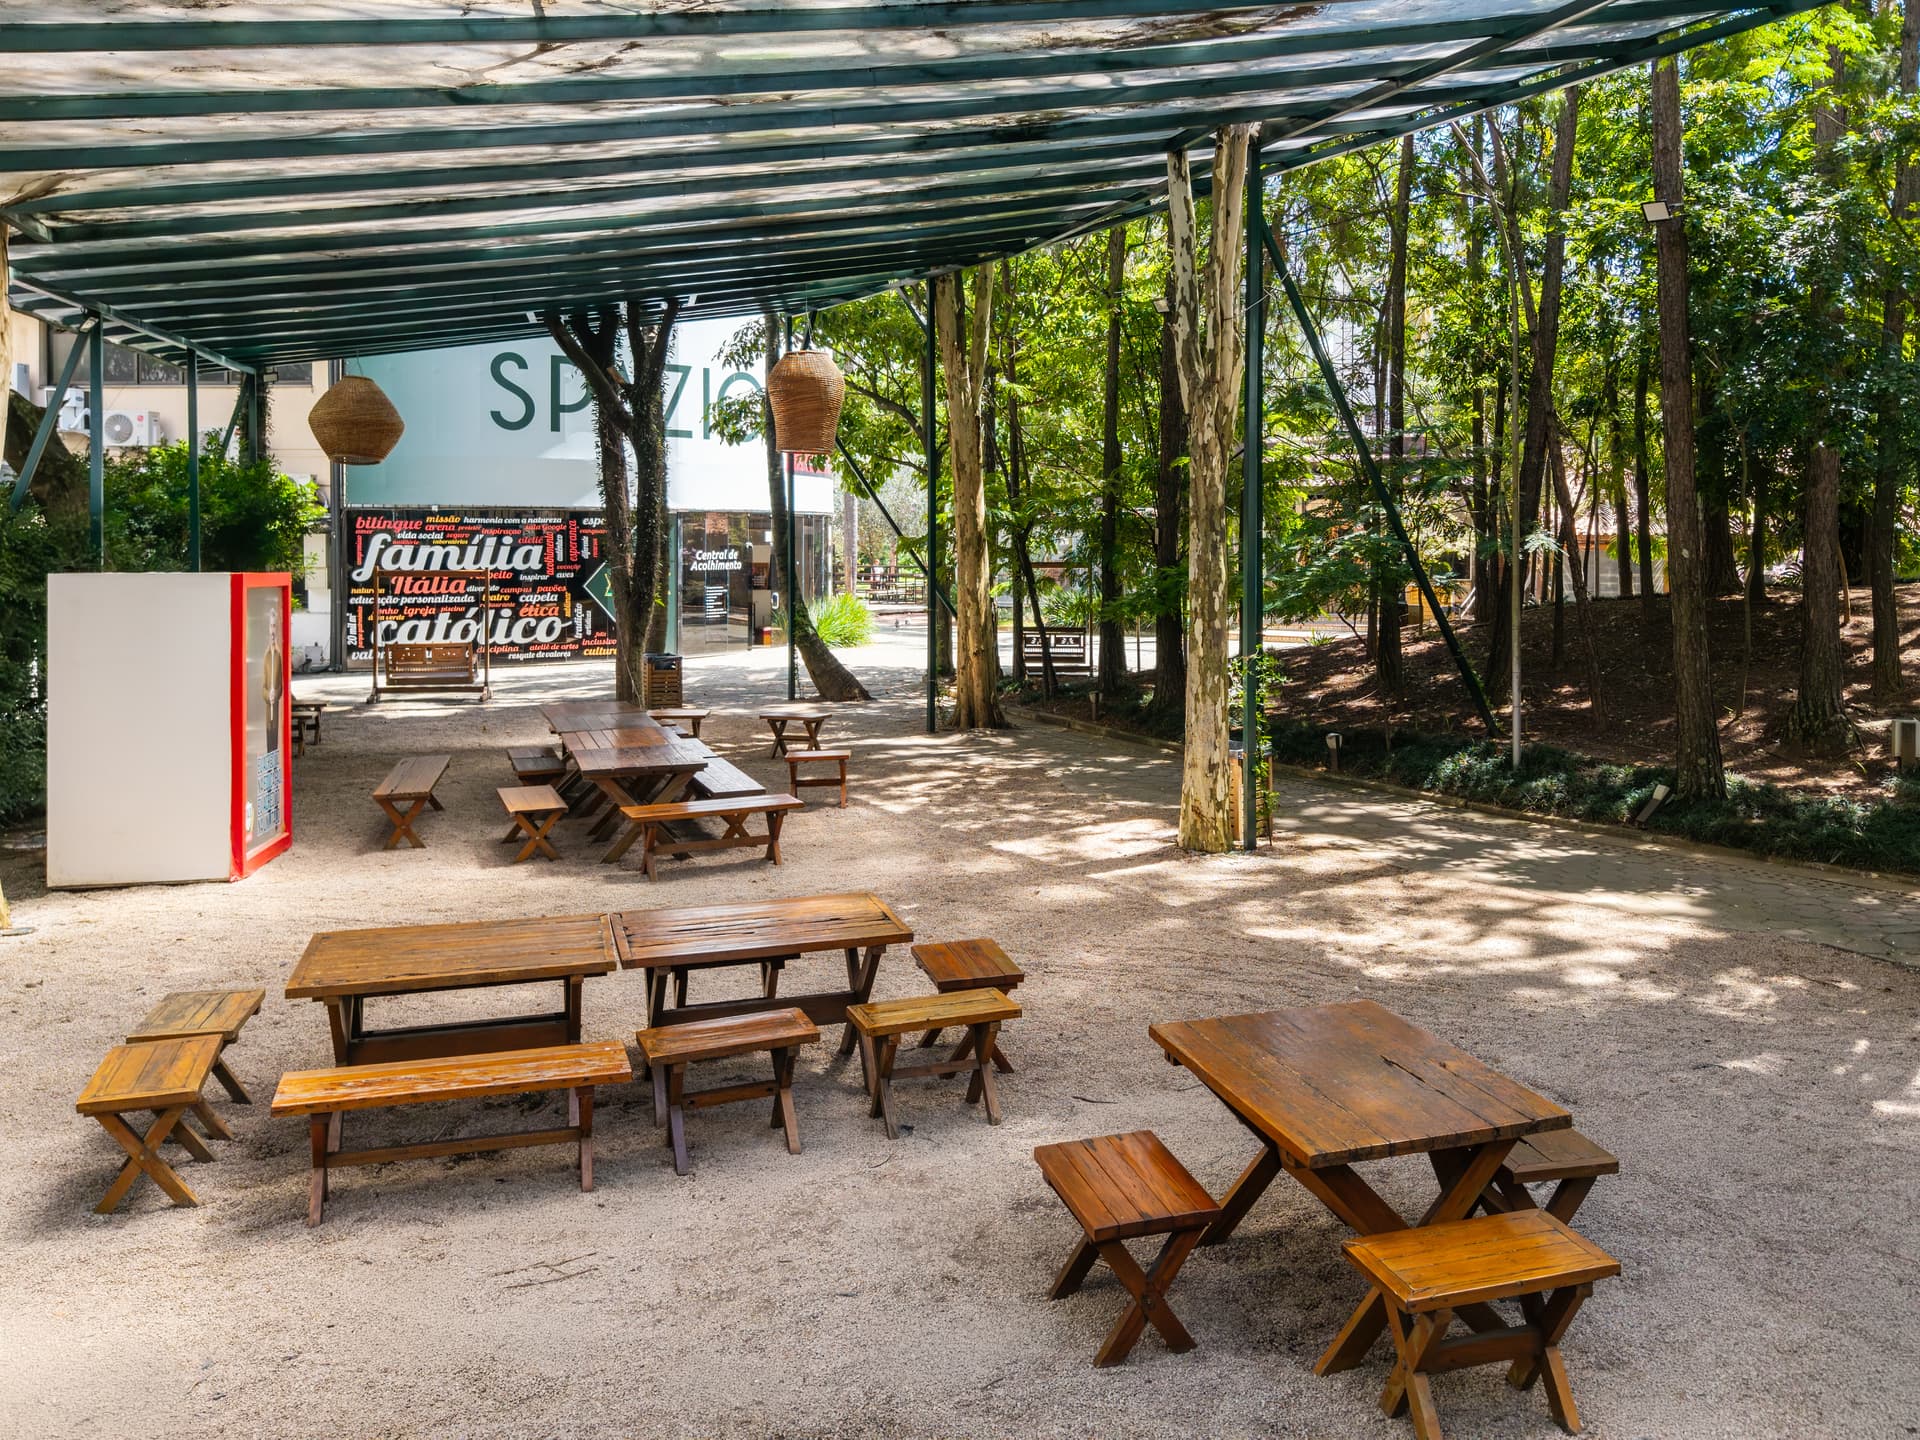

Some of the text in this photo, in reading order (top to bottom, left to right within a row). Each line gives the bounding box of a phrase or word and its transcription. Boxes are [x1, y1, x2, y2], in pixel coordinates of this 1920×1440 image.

[490, 352, 768, 442] SPZIO
[356, 516, 423, 532] bilíngue
[426, 515, 461, 523] missão
[397, 531, 444, 540] vida social
[568, 519, 580, 562] esperança
[351, 533, 544, 582] família
[543, 531, 555, 577] acolhimento
[695, 549, 739, 560] Central de
[690, 560, 743, 571] Acolhimento
[391, 575, 467, 595] Itália
[536, 585, 567, 594] pavões
[400, 594, 476, 606] personalizada
[519, 592, 558, 604] capela
[403, 605, 436, 617] igreja
[519, 603, 560, 618] ética
[575, 603, 584, 638] tradição
[370, 607, 573, 648] católico
[348, 635, 357, 645] 20
[581, 637, 617, 646] inclusivo
[476, 644, 519, 655] diciplina
[545, 651, 571, 659] valores
[583, 646, 617, 656] cultur
